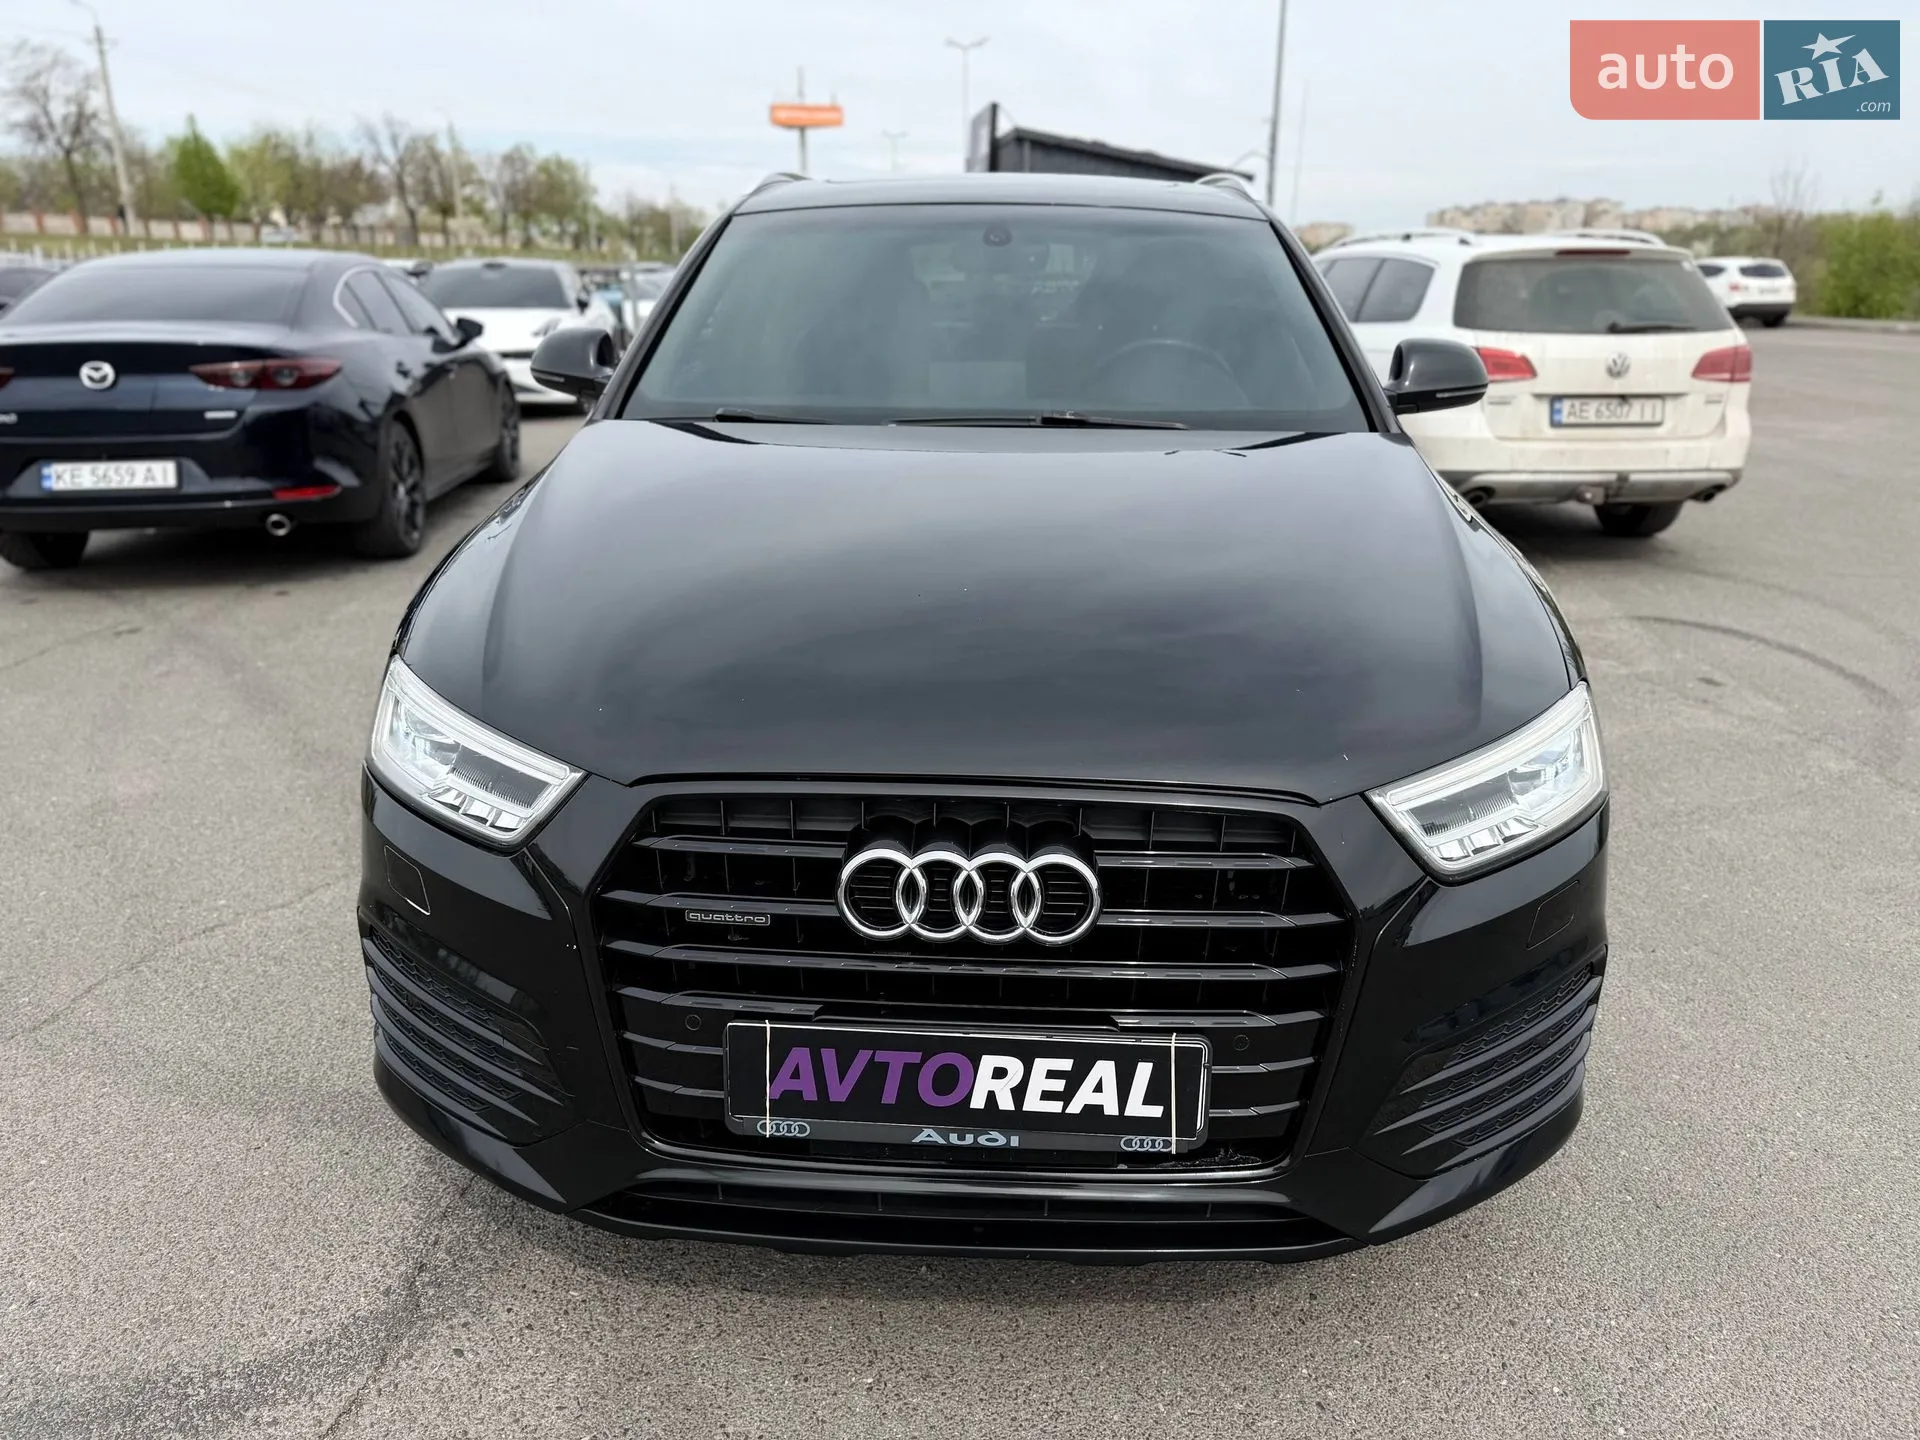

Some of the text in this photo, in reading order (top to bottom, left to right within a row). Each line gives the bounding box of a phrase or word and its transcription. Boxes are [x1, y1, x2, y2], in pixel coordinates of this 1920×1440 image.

[1566, 401, 1590, 420] AE
[54, 467, 84, 487] KE
[89, 464, 137, 486] 5659
[689, 912, 767, 924] quattro
[911, 1128, 1020, 1148] Audi
